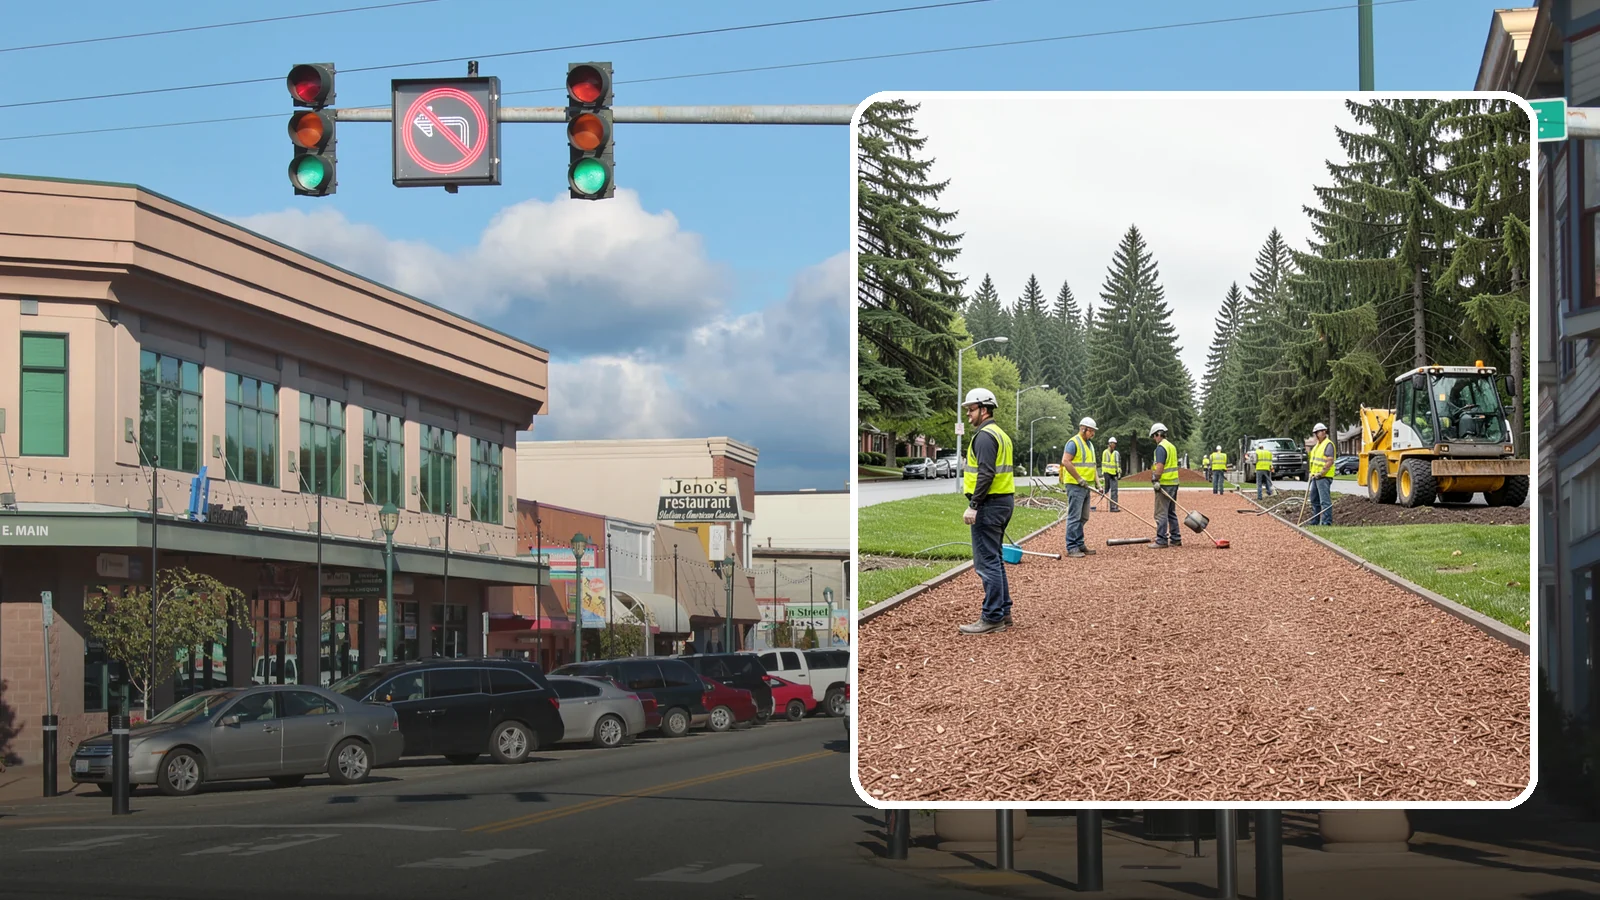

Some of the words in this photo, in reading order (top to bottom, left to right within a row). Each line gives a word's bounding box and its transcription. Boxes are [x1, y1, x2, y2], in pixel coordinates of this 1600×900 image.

[670, 480, 727, 494] Jeno's
[665, 496, 731, 509] restaurant
[658, 509, 682, 519] Italian
[685, 509, 714, 519] American
[714, 509, 737, 519] Cuisine
[2, 525, 13, 536] E.
[15, 525, 49, 536] MAIN
[797, 607, 828, 617] Street
[791, 619, 823, 627] lass
